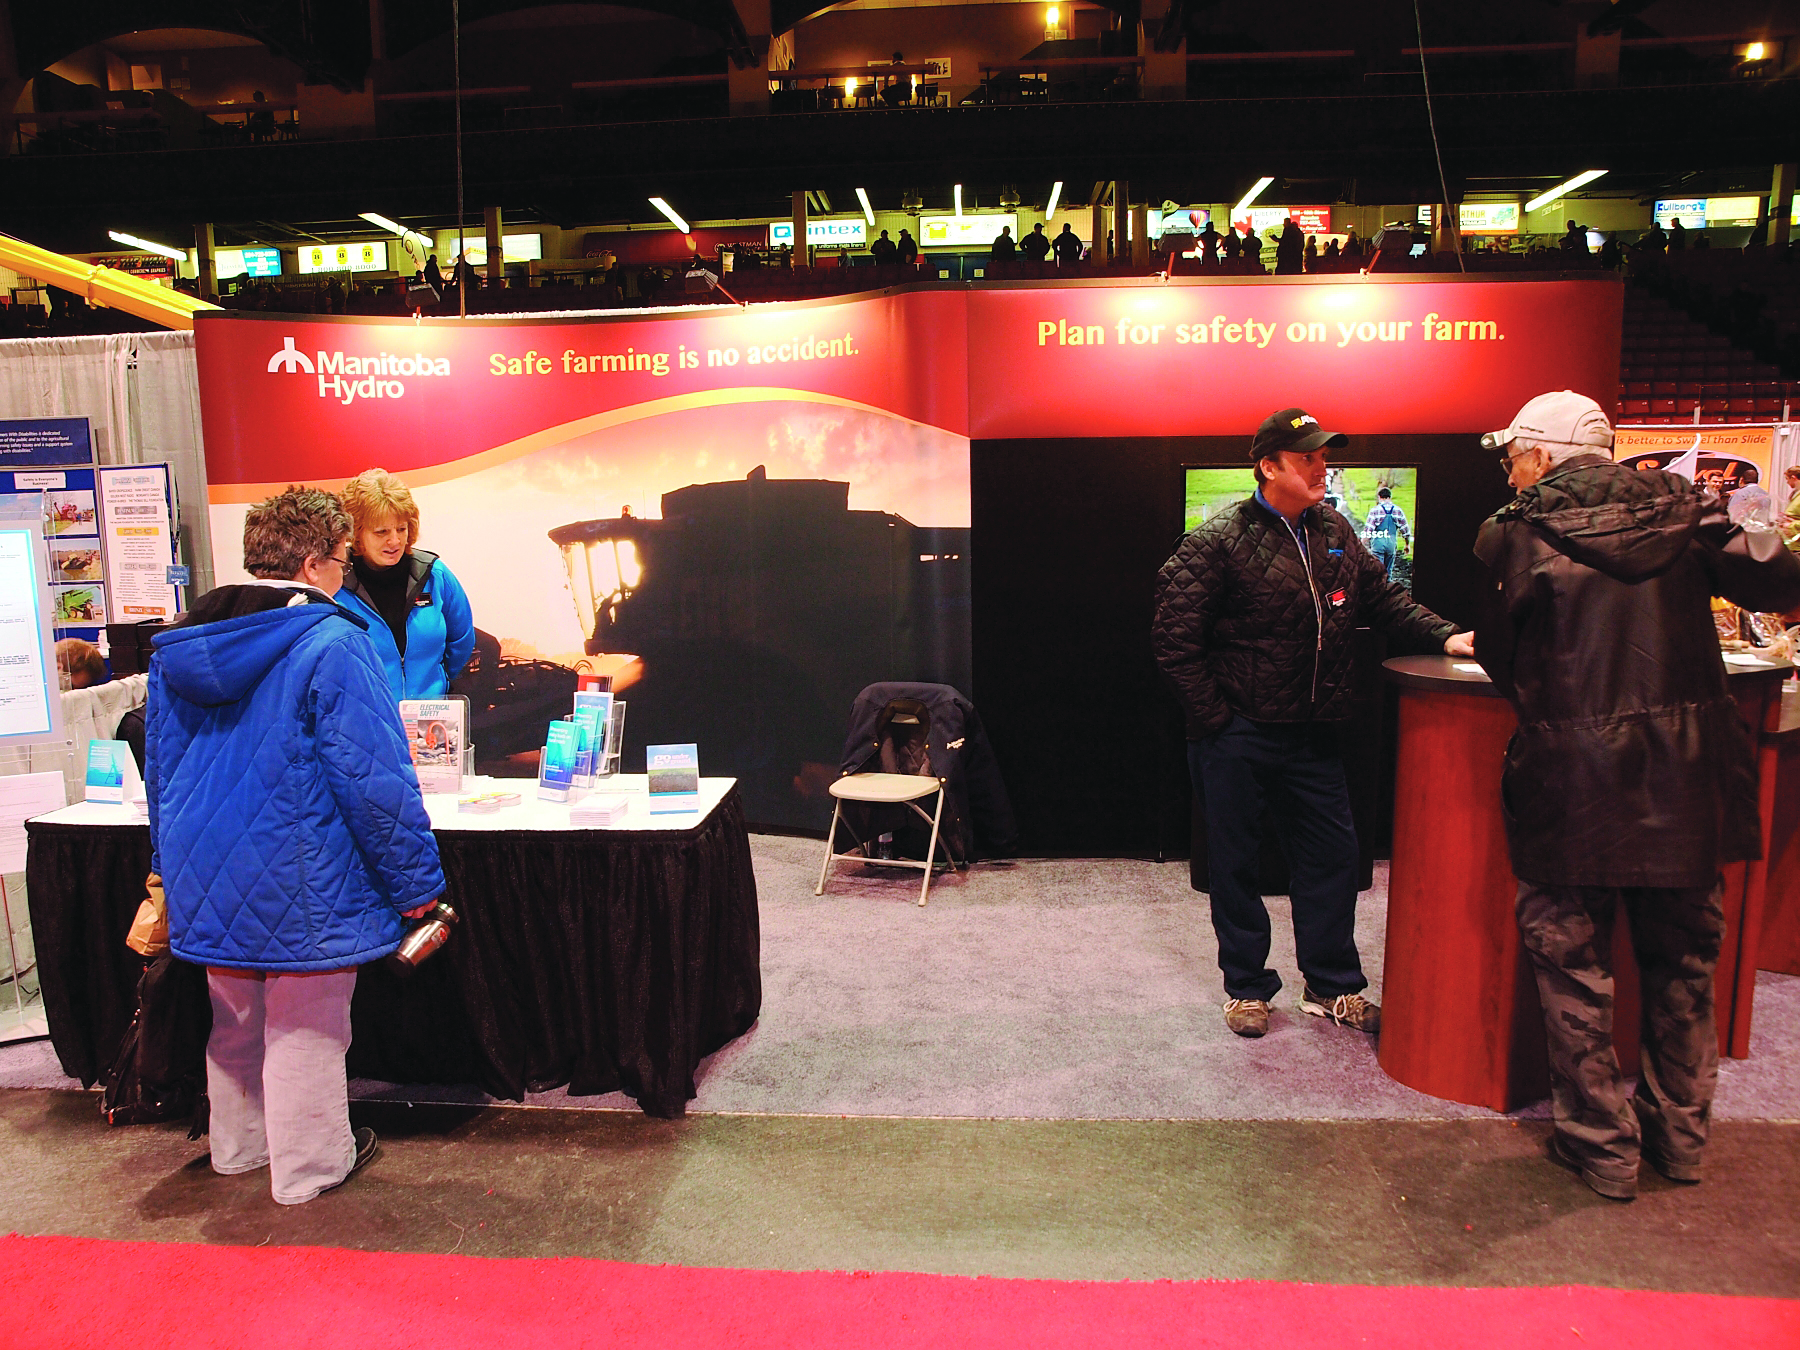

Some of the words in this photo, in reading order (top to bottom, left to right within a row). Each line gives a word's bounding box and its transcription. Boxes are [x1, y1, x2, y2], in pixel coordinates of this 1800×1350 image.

[1038, 318, 1105, 346] Plan
[1114, 317, 1166, 345] for
[1175, 315, 1277, 348] safety
[1286, 321, 1327, 342] on
[1336, 320, 1413, 348] your
[1421, 312, 1505, 341] farm.
[317, 351, 451, 376] Manitoba
[489, 351, 552, 375] Safe
[561, 347, 670, 376] farming
[679, 345, 699, 369] is
[708, 347, 740, 367] no
[747, 332, 859, 365] accident.
[318, 375, 405, 405] Hydro
[1616, 436, 1624, 444] is
[1628, 436, 1659, 444] better
[1676, 436, 1711, 445] Swiel
[1714, 435, 1738, 444] than
[1741, 435, 1767, 444] Slide
[1360, 529, 1391, 539] asset.
[654, 754, 671, 766] go
